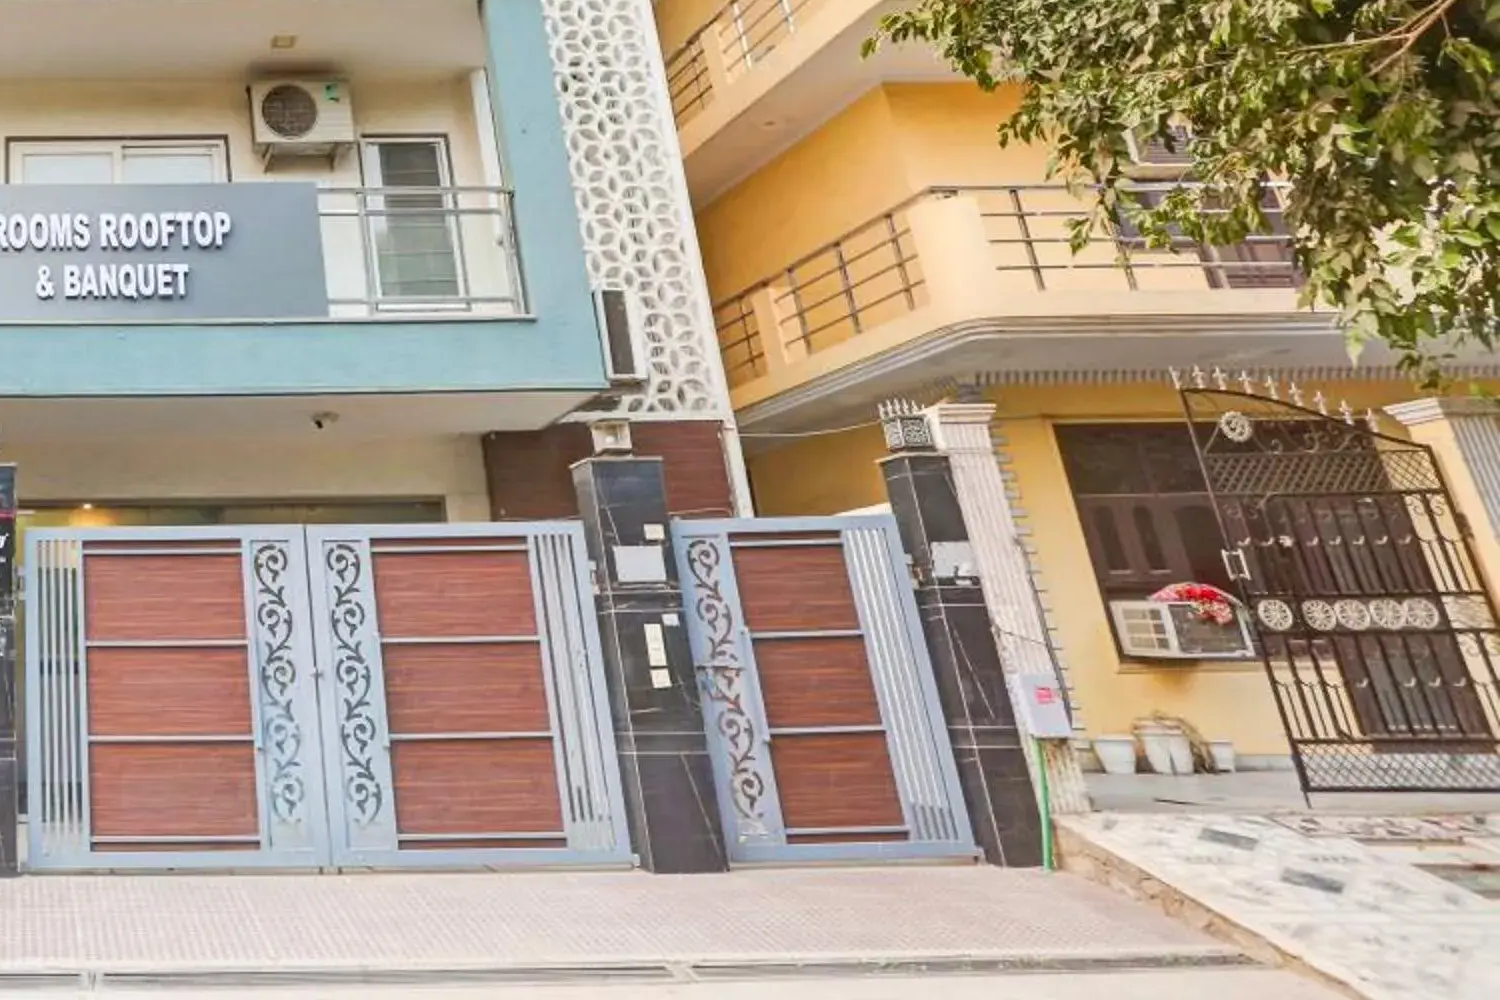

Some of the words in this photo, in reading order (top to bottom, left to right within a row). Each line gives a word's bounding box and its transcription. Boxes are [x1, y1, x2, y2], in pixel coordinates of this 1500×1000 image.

[100, 211, 232, 249] ROOFTOP
[36, 264, 55, 299] &
[64, 263, 189, 300] BANQUET
